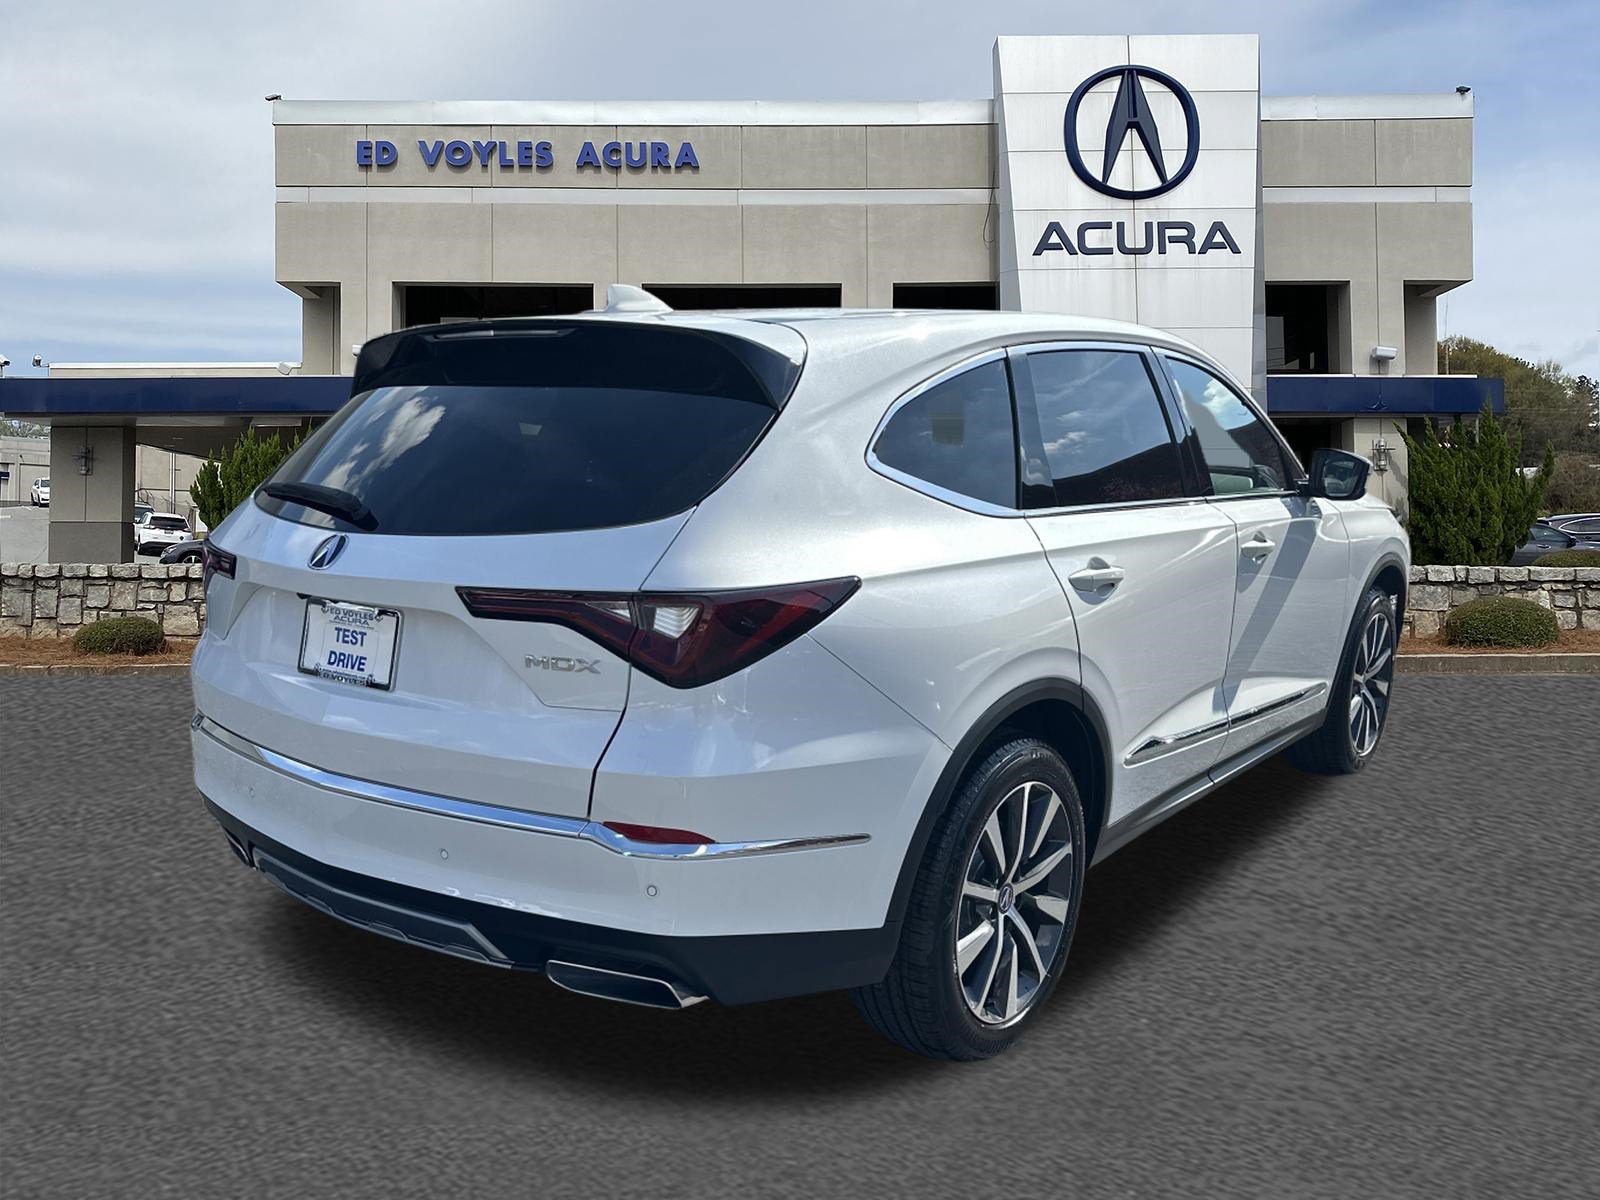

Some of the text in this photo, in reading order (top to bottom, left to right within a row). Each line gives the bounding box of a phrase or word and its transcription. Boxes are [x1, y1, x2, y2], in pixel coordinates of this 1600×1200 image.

[356, 140, 700, 168] ED VOYLES ACURA
[1032, 221, 1242, 256] ACURA
[330, 607, 374, 621] ED VOYLES
[333, 615, 370, 626] ACURA
[335, 626, 367, 647] TEST
[327, 650, 367, 672] DRIVE
[524, 654, 601, 674] MDX
